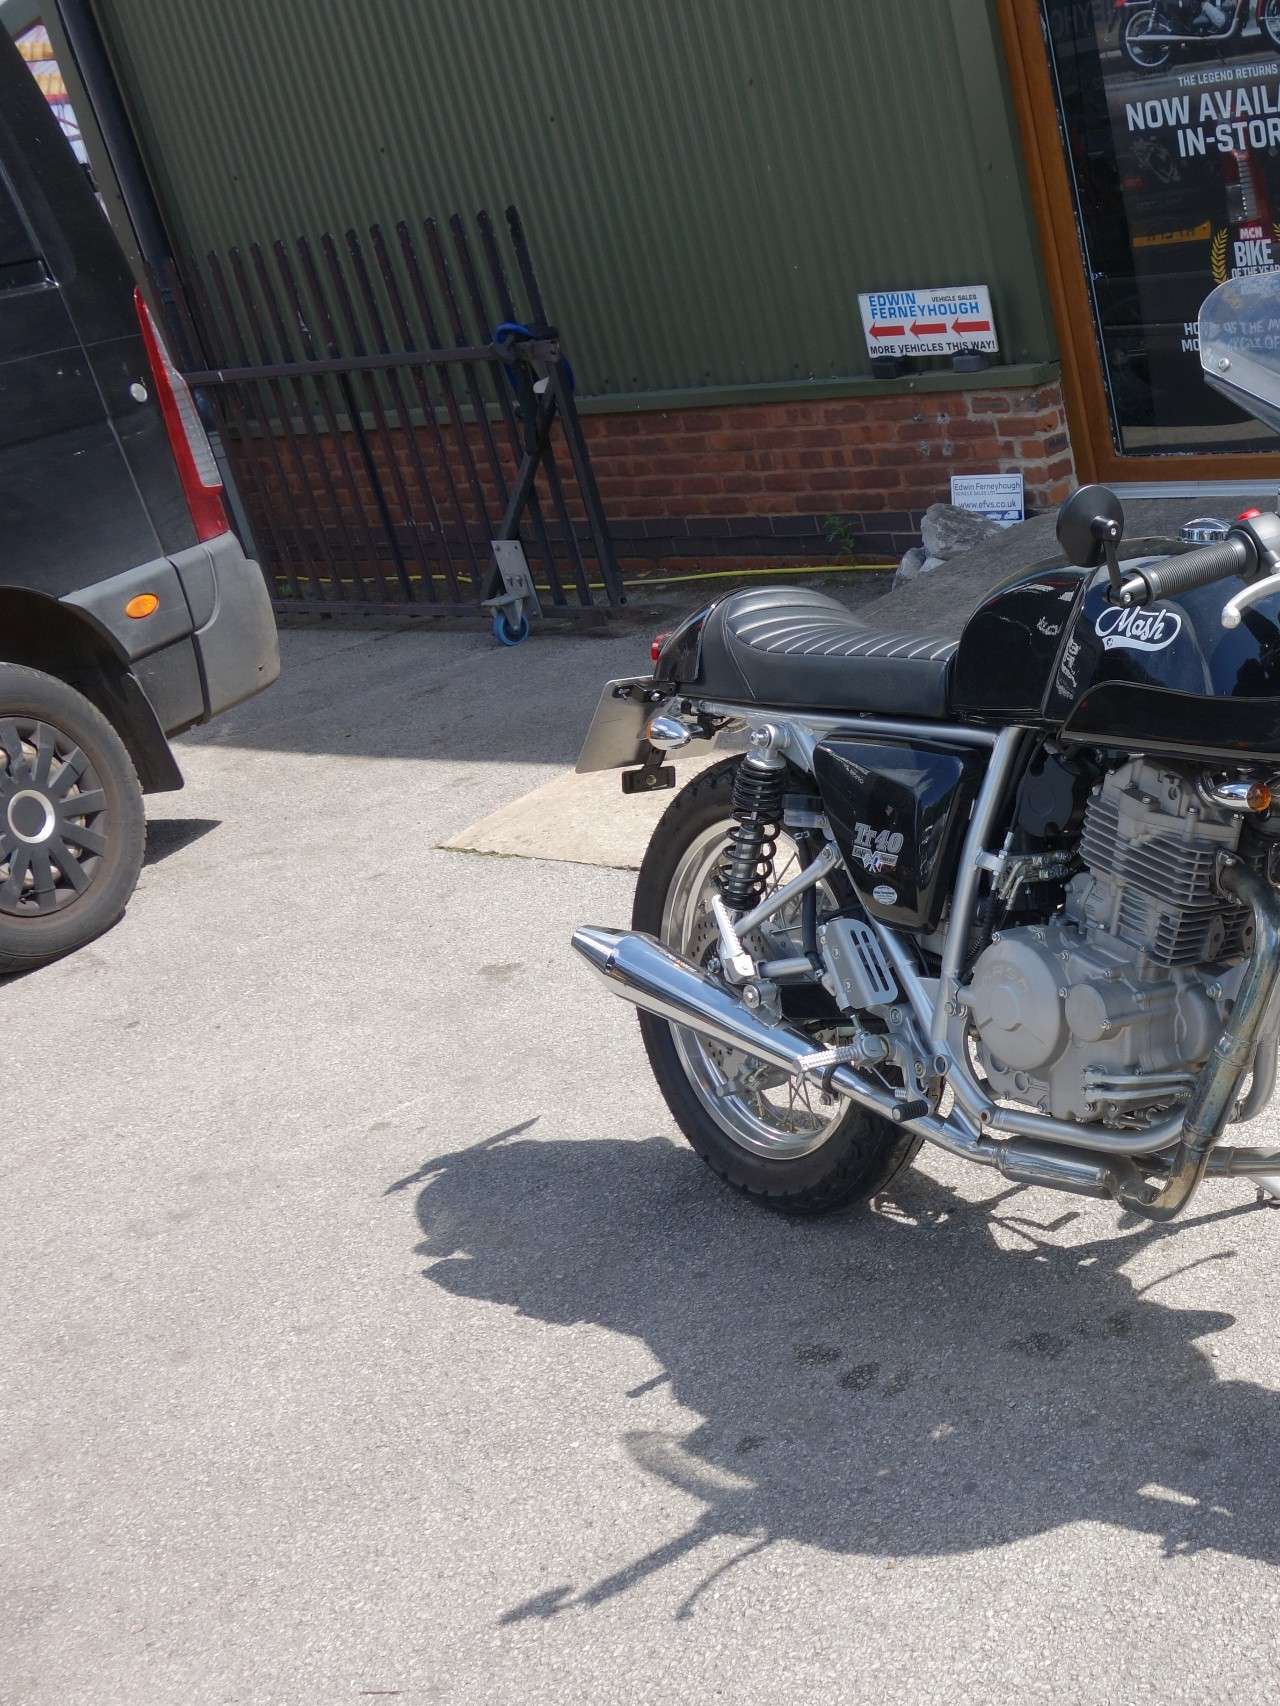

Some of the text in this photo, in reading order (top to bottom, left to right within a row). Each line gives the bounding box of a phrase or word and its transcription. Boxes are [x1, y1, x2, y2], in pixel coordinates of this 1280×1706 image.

[1178, 64, 1278, 87] THE LEGEND RETURNS
[1125, 95, 1190, 131] NOW
[1240, 226, 1263, 240] MCN
[1233, 239, 1274, 267] BIKE
[868, 292, 916, 307] EDWIN
[931, 295, 956, 303] VEHICLE
[871, 302, 980, 320] FERNEYHOUGH
[870, 340, 995, 355] MORE VEHICLES THIS WAY!
[954, 481, 1020, 491] Edwin Ferneyhough
[959, 499, 1017, 508] www.efvs.co.uk
[1096, 606, 1175, 643] Mash
